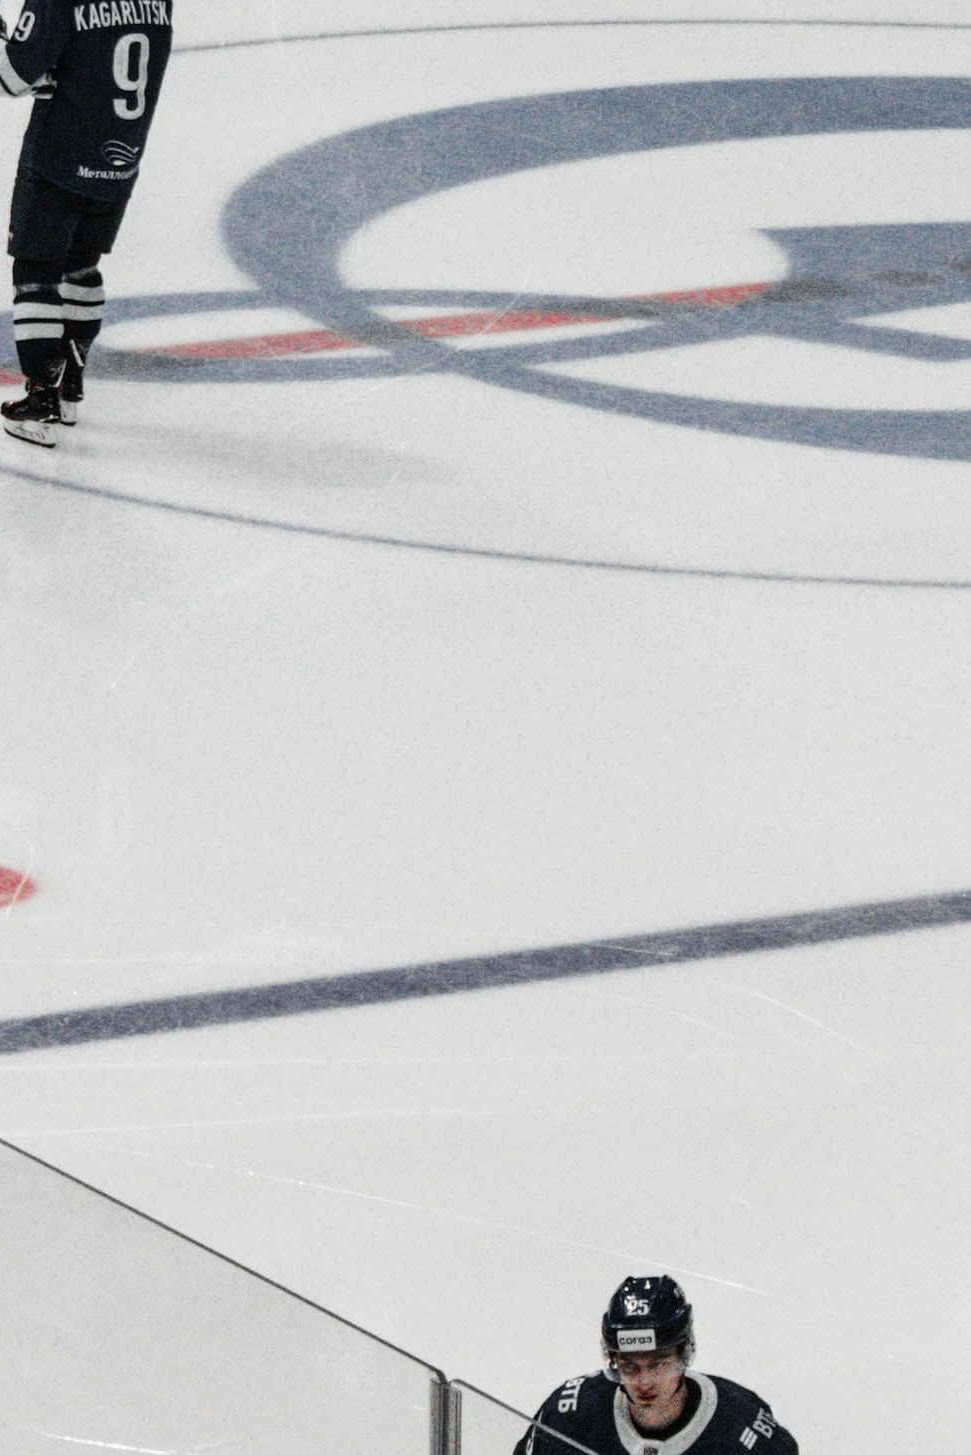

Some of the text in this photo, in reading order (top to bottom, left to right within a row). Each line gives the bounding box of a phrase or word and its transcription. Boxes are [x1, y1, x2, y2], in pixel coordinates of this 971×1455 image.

[14, 10, 36, 43] 9
[74, 0, 170, 32] KAGARLITSK
[112, 33, 150, 120] 9
[626, 1298, 650, 1317] 25
[557, 1376, 587, 1414] ВТБ
